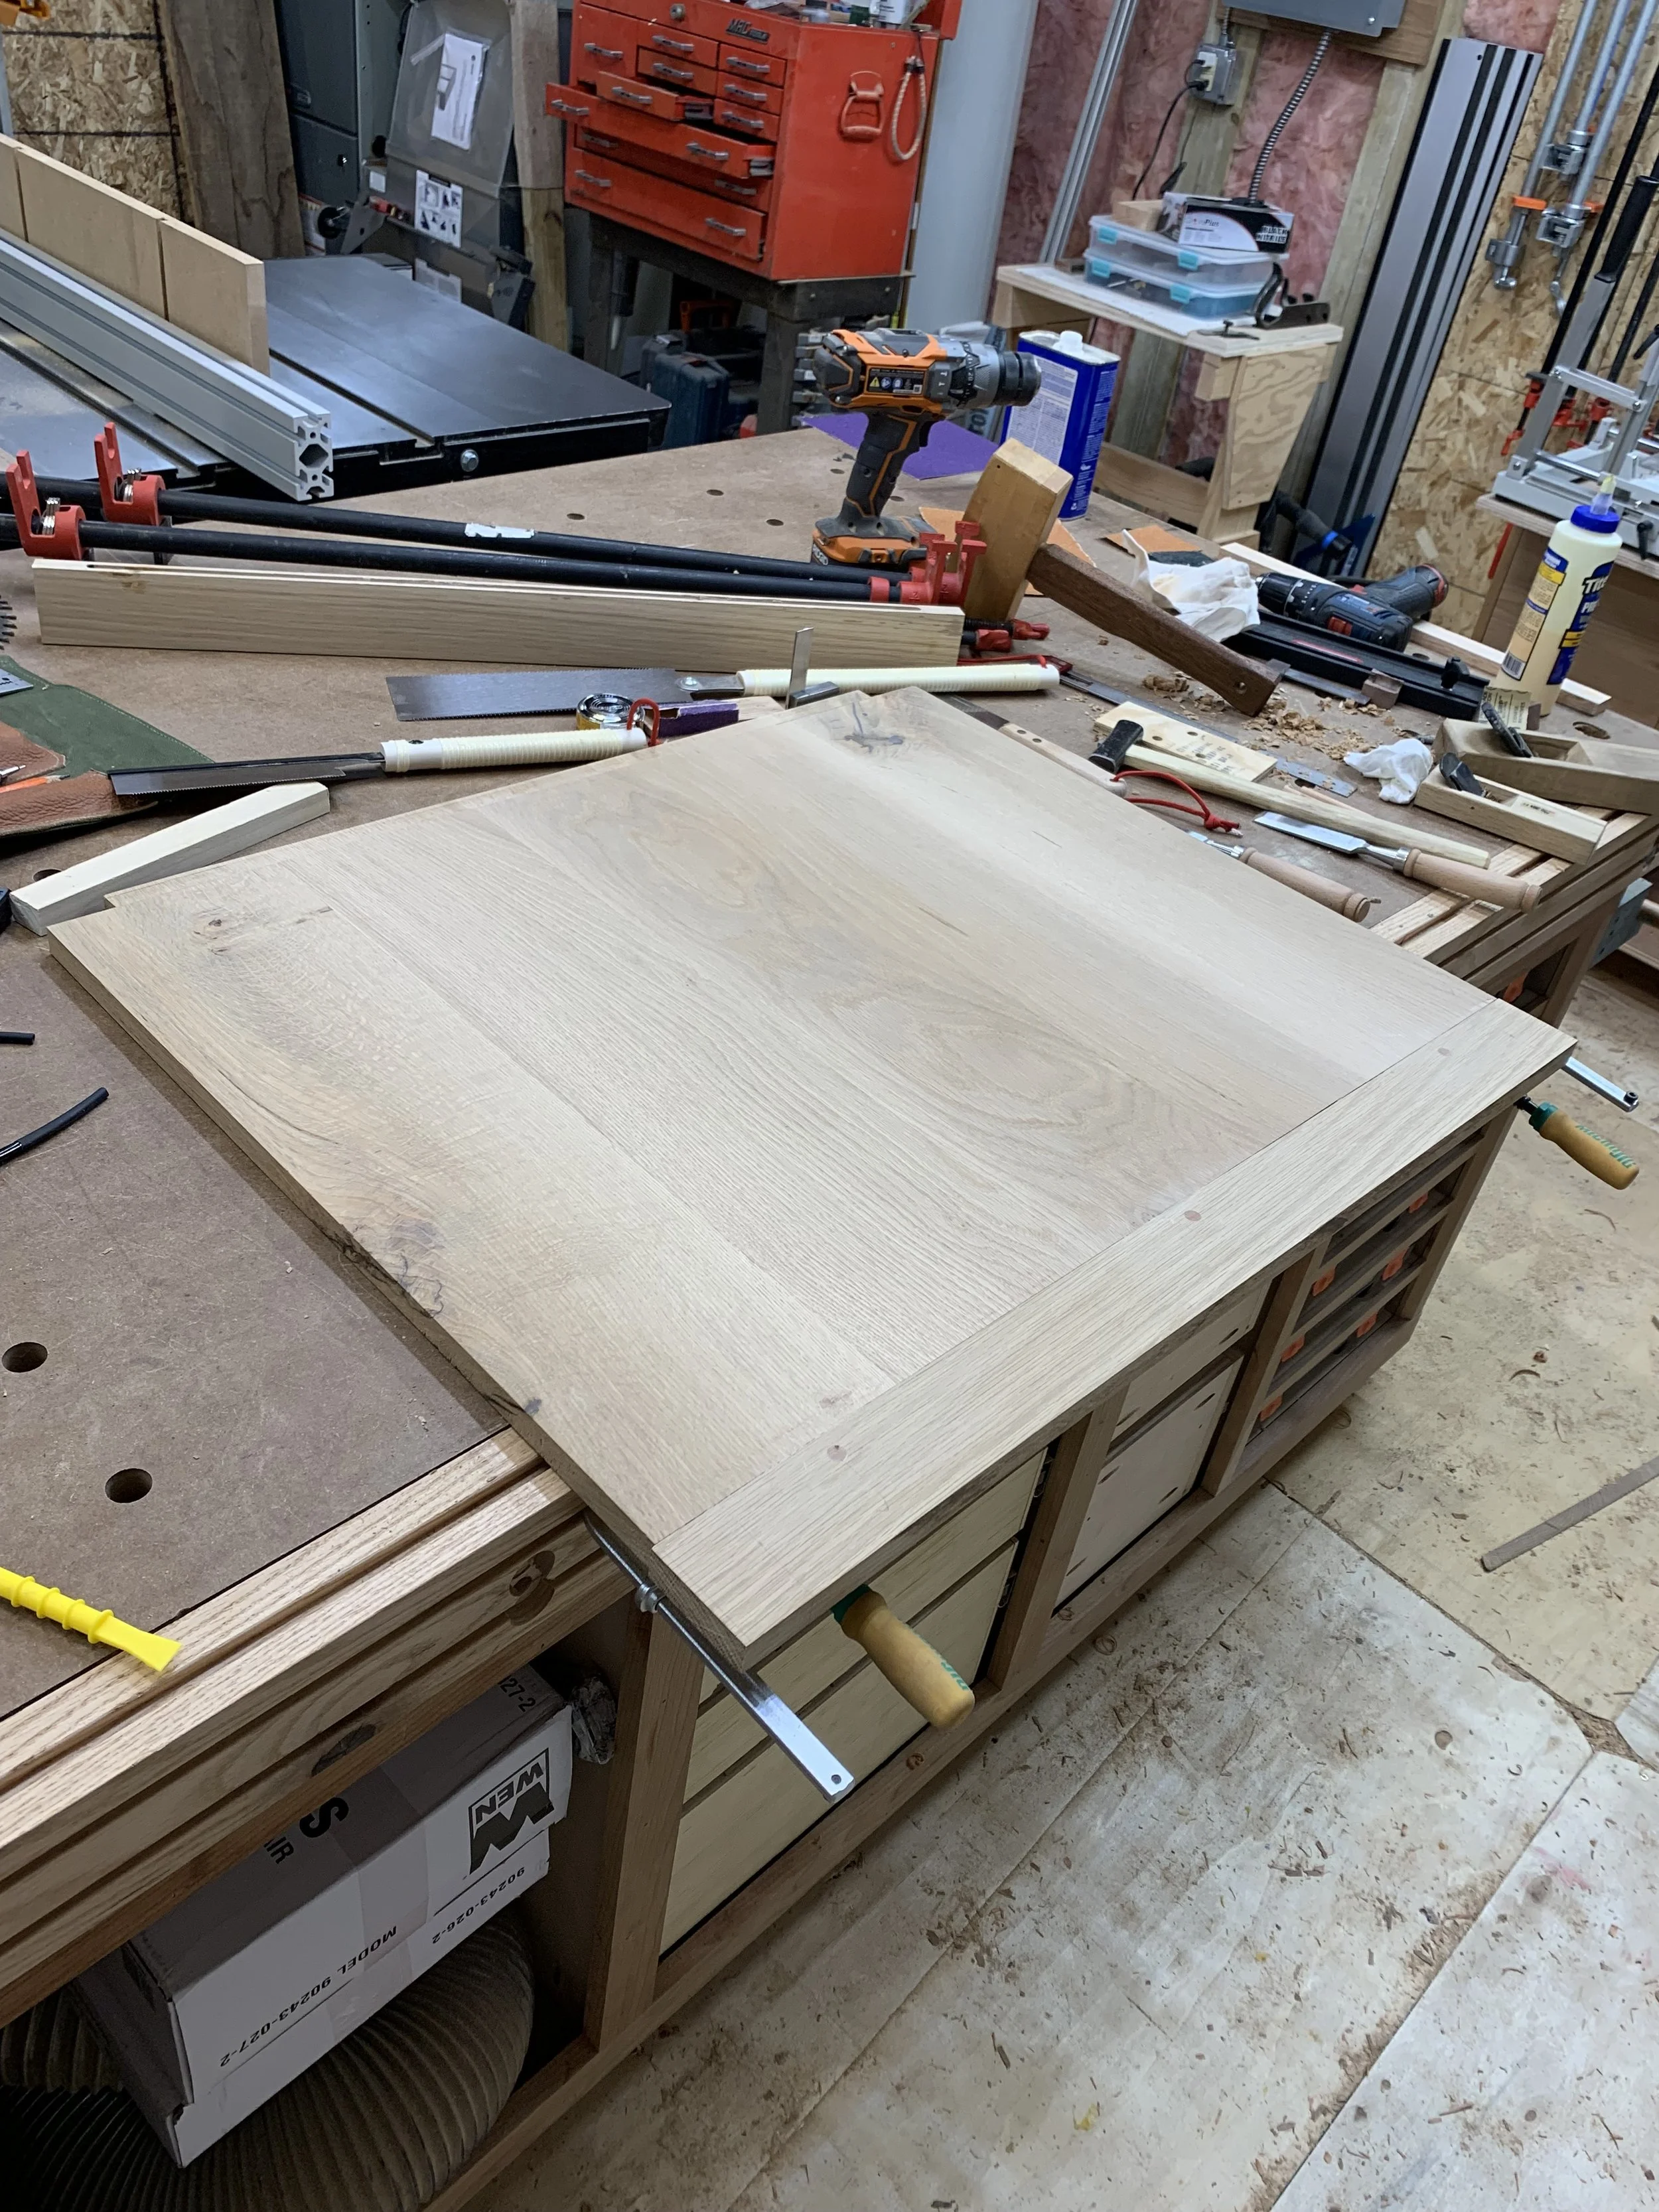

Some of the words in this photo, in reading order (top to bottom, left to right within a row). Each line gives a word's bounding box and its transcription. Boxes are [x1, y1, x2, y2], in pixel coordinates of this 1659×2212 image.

[498, 1674, 536, 1713] 27-2
[474, 1761, 544, 1825] WEN
[263, 1836, 294, 1864] IR
[432, 1866, 525, 1945] 90243-026-2
[336, 1925, 397, 1975] MODEL
[220, 1976, 332, 2068] 90243-027-2
